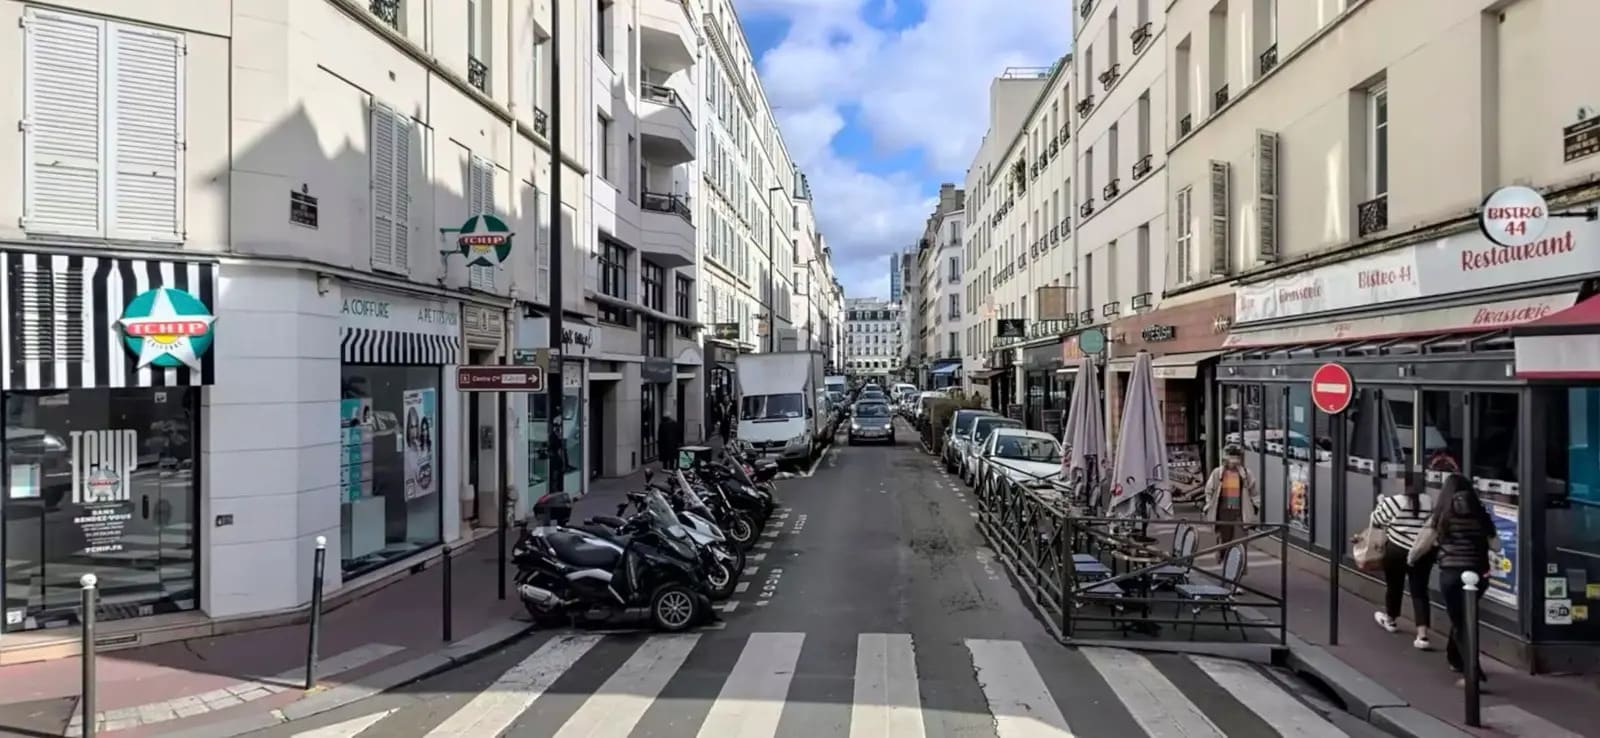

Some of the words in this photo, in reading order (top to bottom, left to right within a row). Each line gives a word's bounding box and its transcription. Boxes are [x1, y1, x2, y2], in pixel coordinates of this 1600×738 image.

[1488, 206, 1545, 220] BISTRO
[1504, 221, 1526, 236] 44
[464, 236, 503, 245] TCHIP
[1461, 231, 1575, 272] Restaurant
[1358, 269, 1396, 289] Bistro
[1399, 265, 1411, 284] 44
[351, 299, 391, 319] COIFFURE
[1473, 303, 1550, 324] Brasserie
[133, 322, 202, 335] TCHIP
[69, 429, 138, 503] TCHIP
[74, 513, 132, 524] RENDEZ-VOUS
[91, 508, 115, 516] SANS
